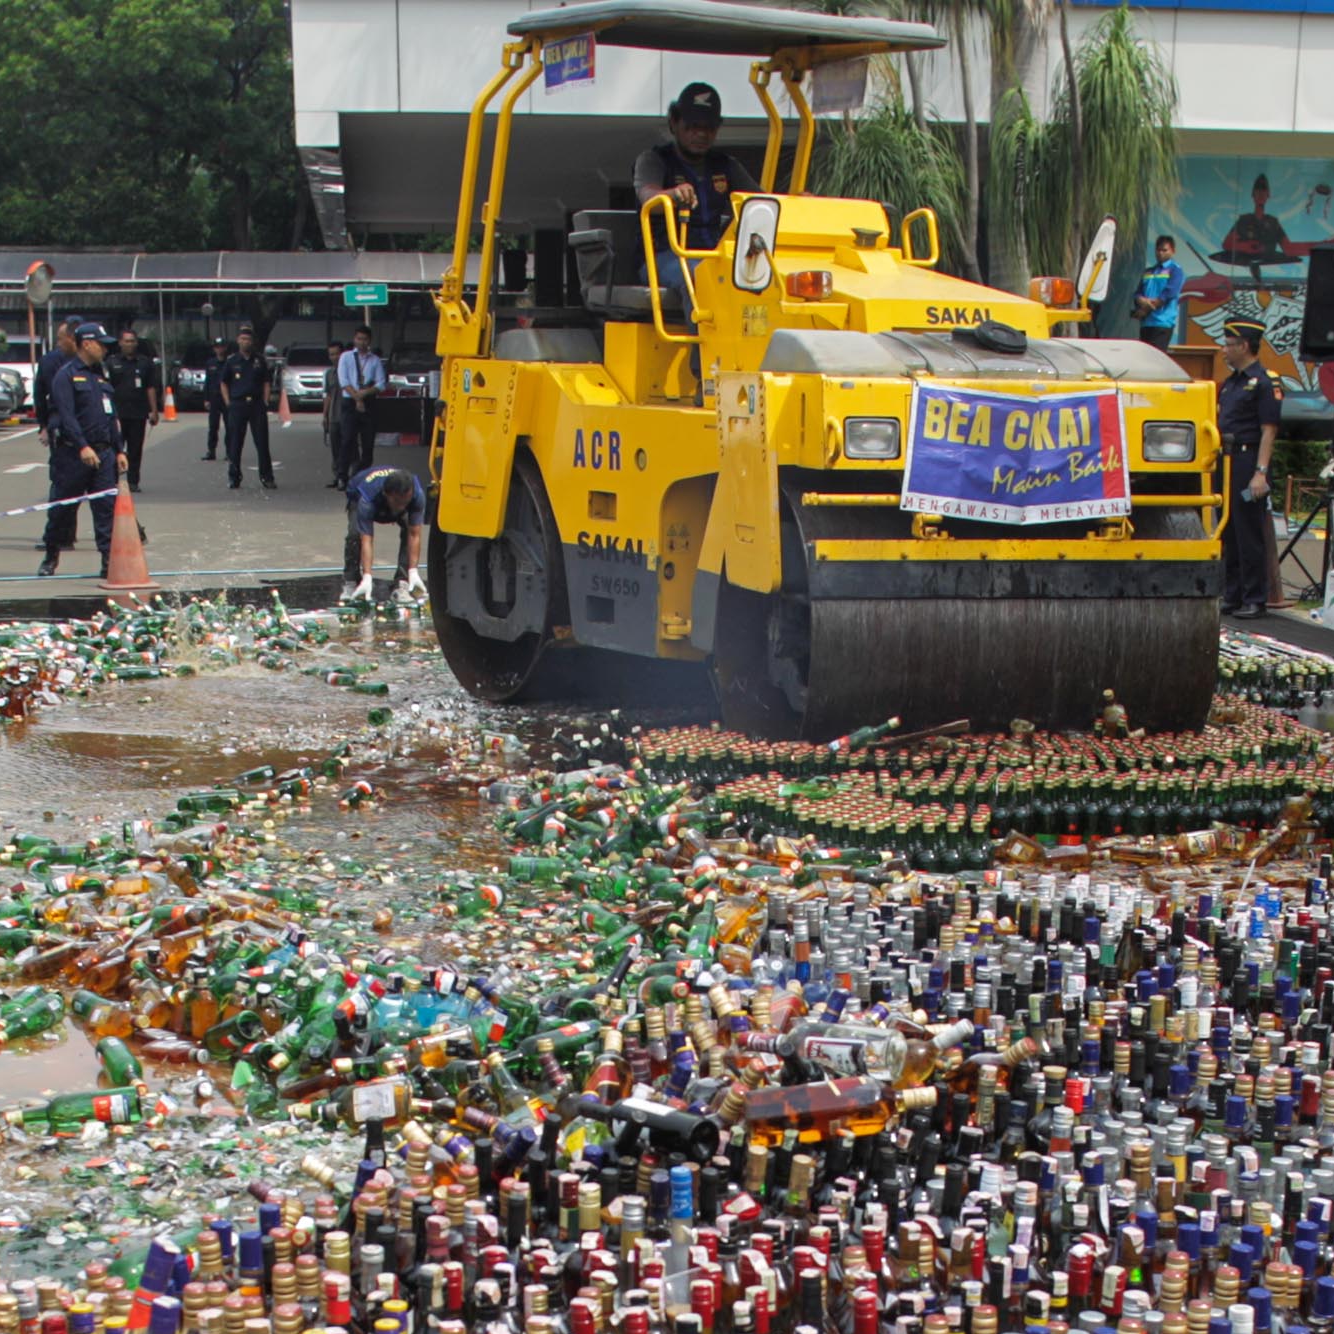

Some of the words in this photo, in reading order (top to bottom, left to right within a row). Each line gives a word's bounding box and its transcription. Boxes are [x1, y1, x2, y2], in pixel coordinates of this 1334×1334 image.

[925, 305, 991, 325] SAKAI
[923, 397, 992, 448] BEA
[1003, 406, 1091, 452] CKAI
[572, 428, 621, 472] ACR
[991, 466, 1061, 495] Main
[1066, 445, 1121, 483] Baik
[904, 495, 1009, 522] MENGAWASI
[576, 531, 644, 567] SAKAI
[591, 575, 641, 598] SW650
